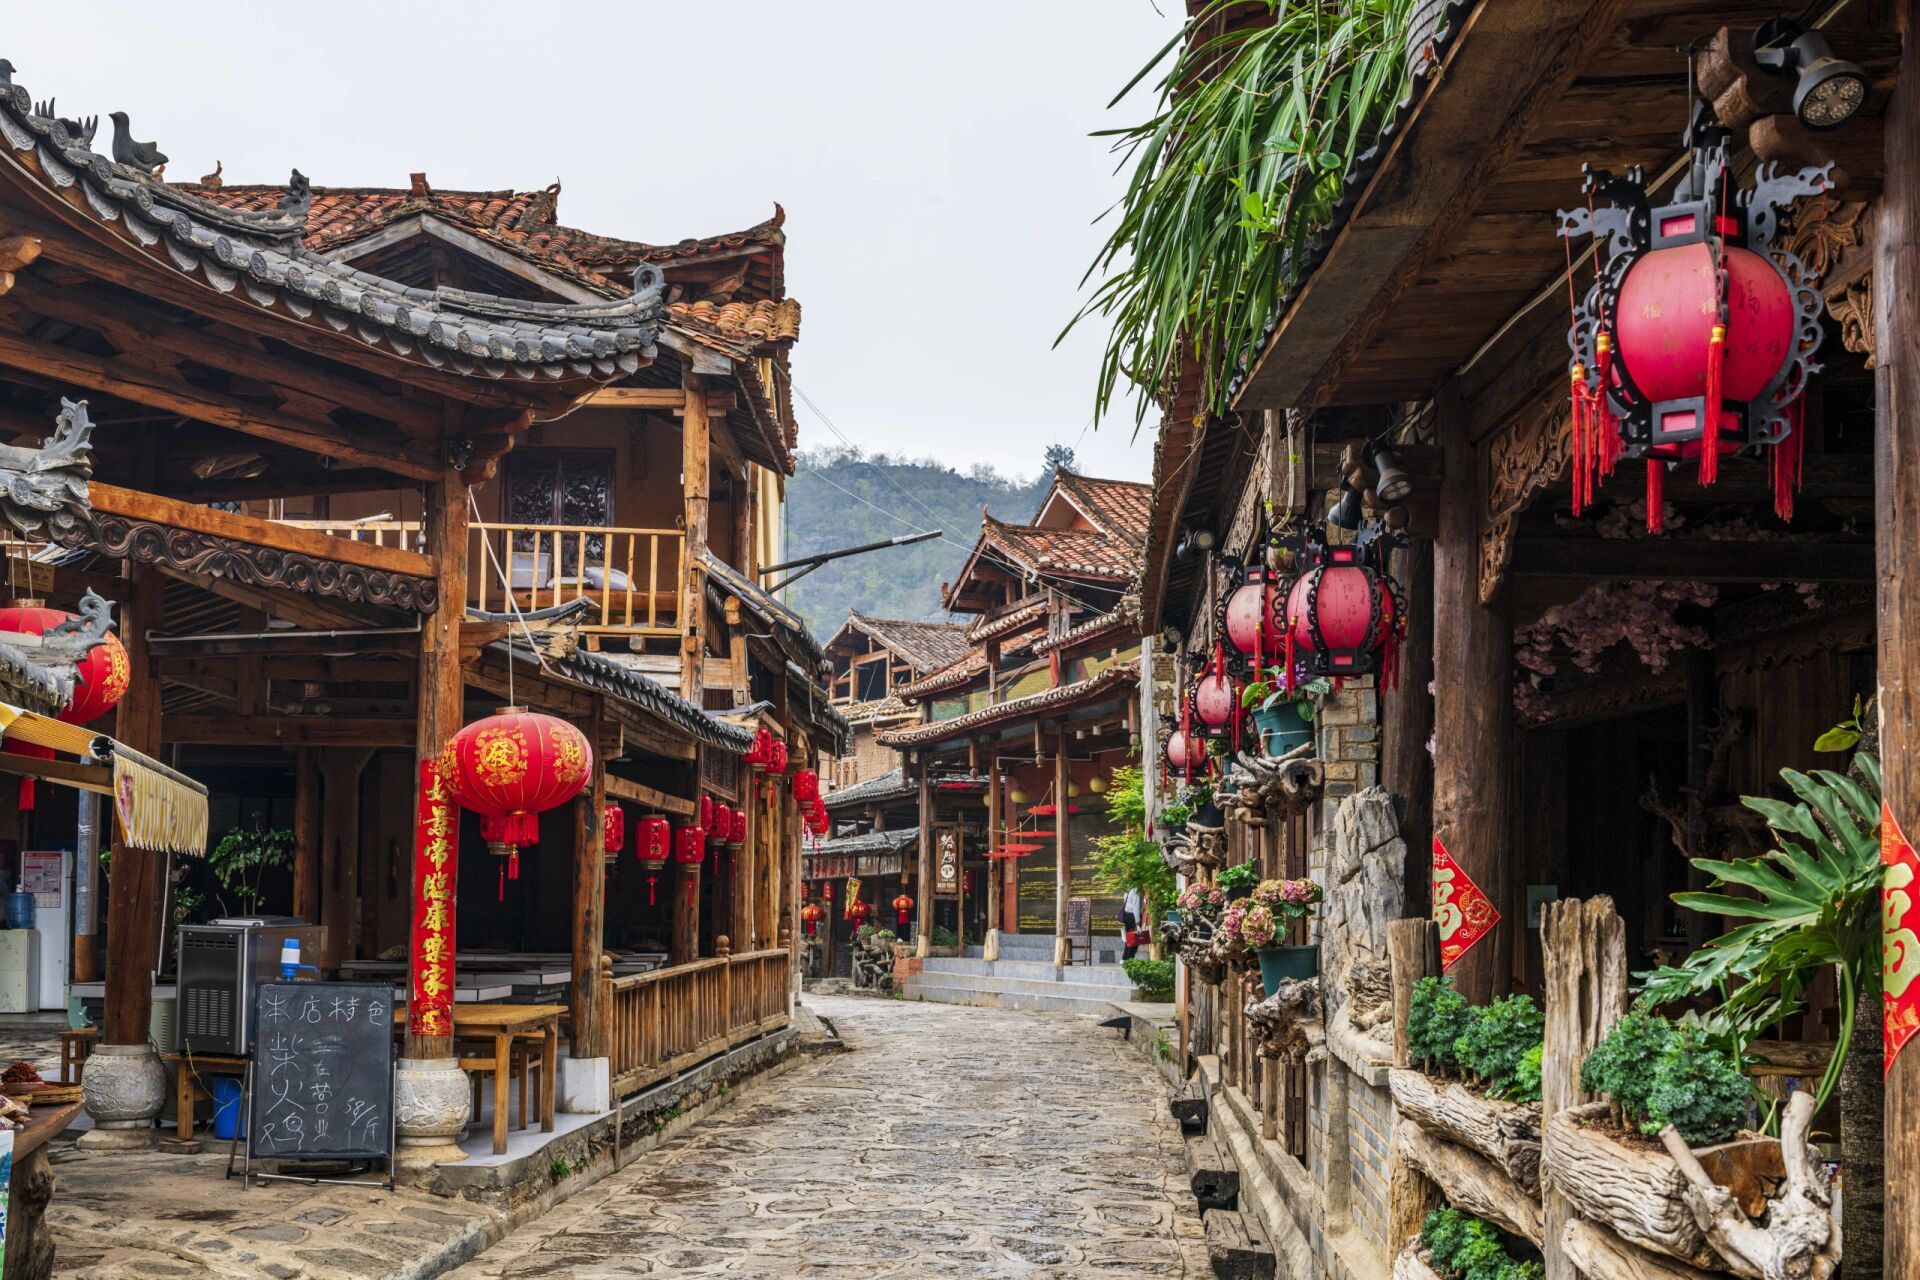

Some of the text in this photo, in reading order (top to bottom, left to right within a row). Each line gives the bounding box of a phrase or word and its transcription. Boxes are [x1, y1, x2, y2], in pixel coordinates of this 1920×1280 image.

[265, 994, 387, 1026] 本店特色
[259, 1031, 305, 1152] 柴火鸡
